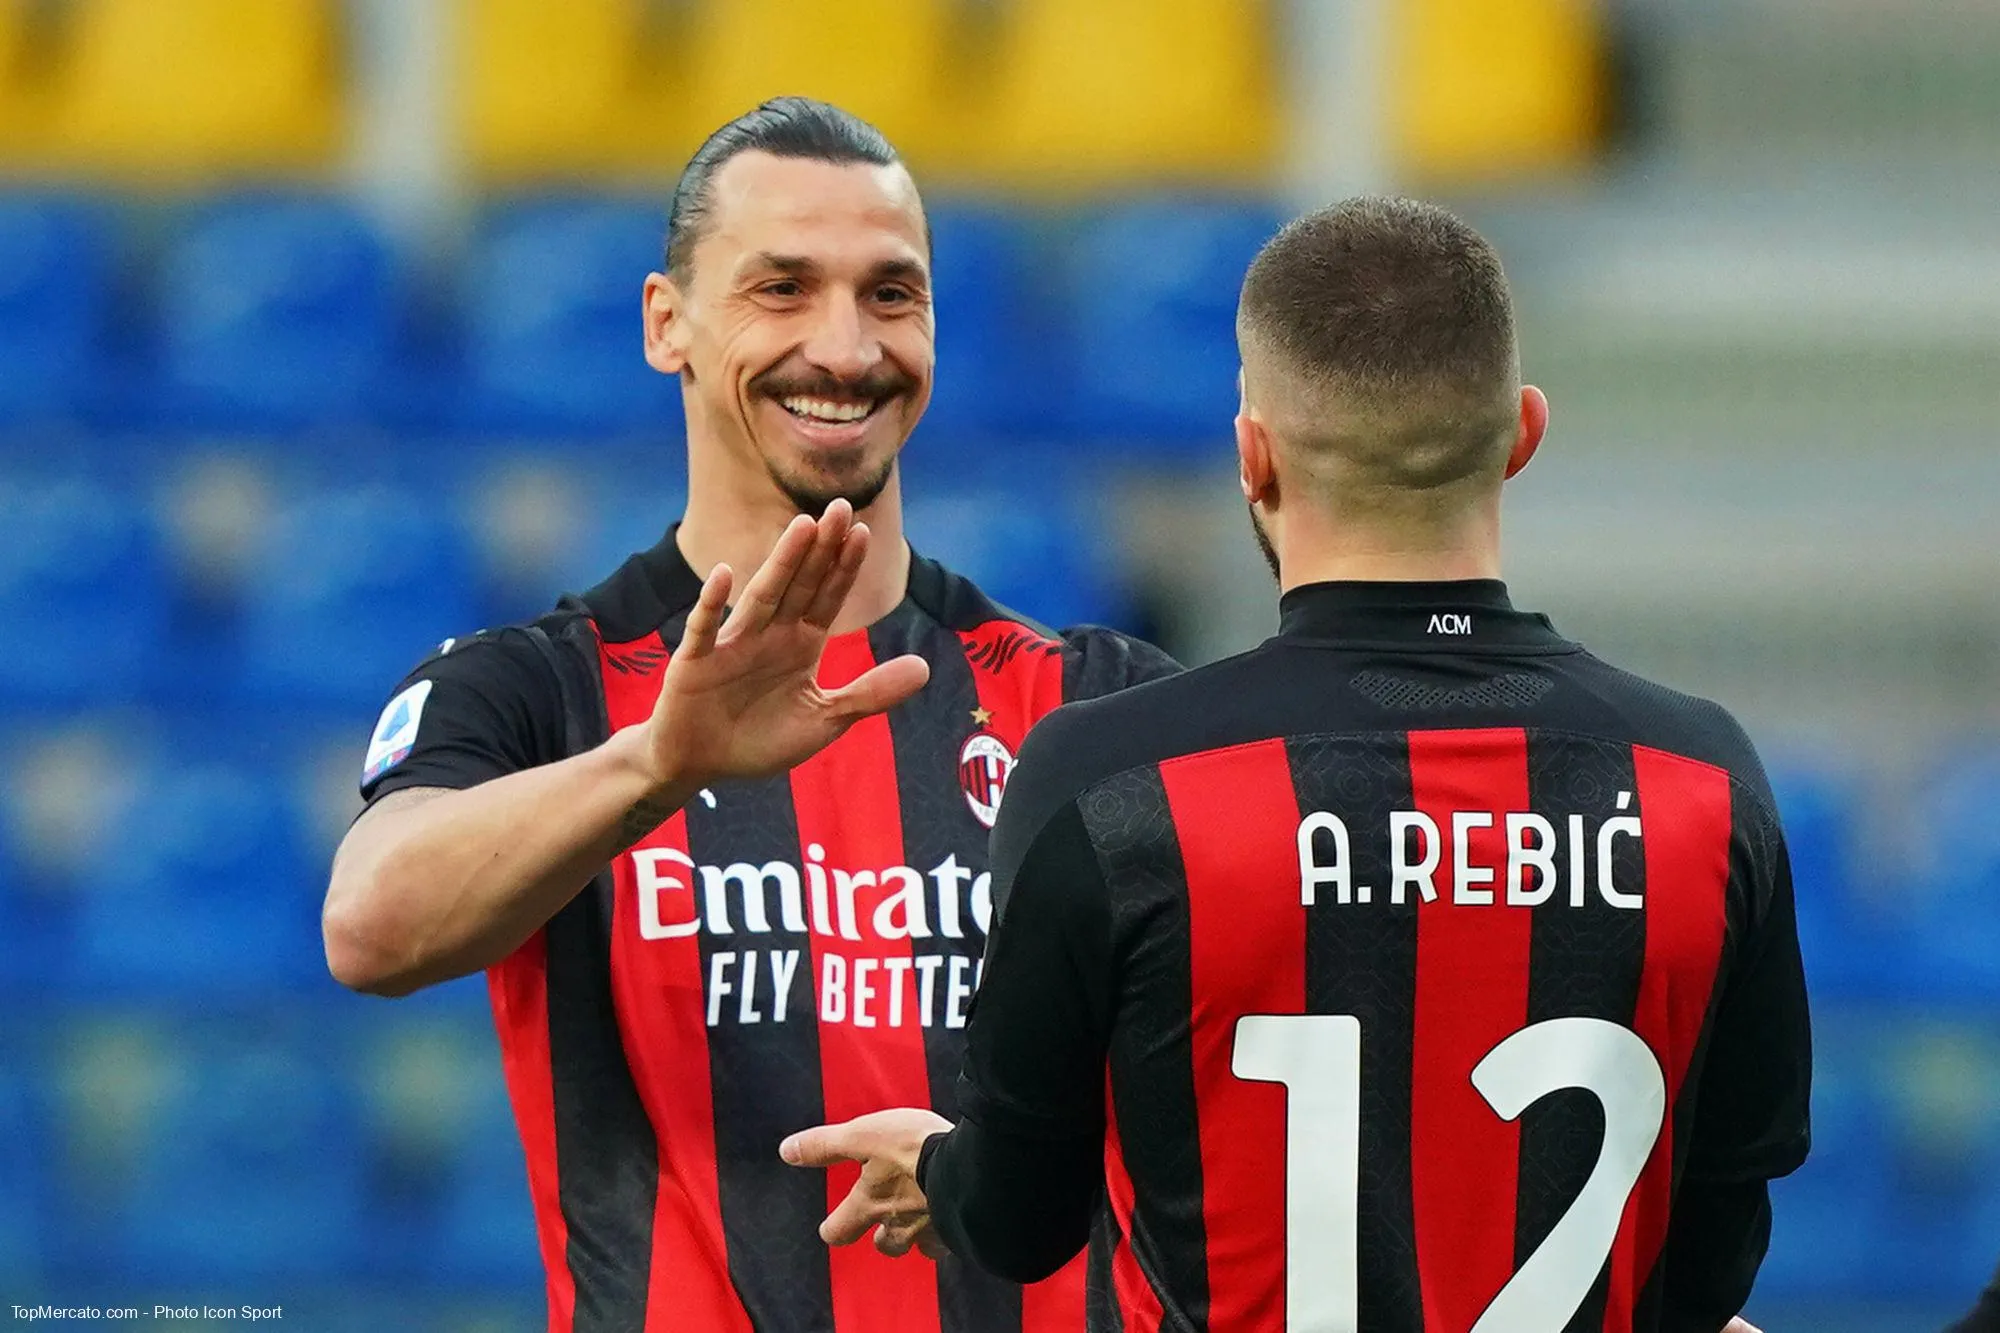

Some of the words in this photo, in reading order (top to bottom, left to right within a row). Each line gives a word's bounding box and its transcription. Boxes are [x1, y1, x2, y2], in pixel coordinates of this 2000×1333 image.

[706, 948, 800, 1027] FLY
[820, 952, 985, 1029] BETTE
[1231, 1014, 1667, 1333] 12
